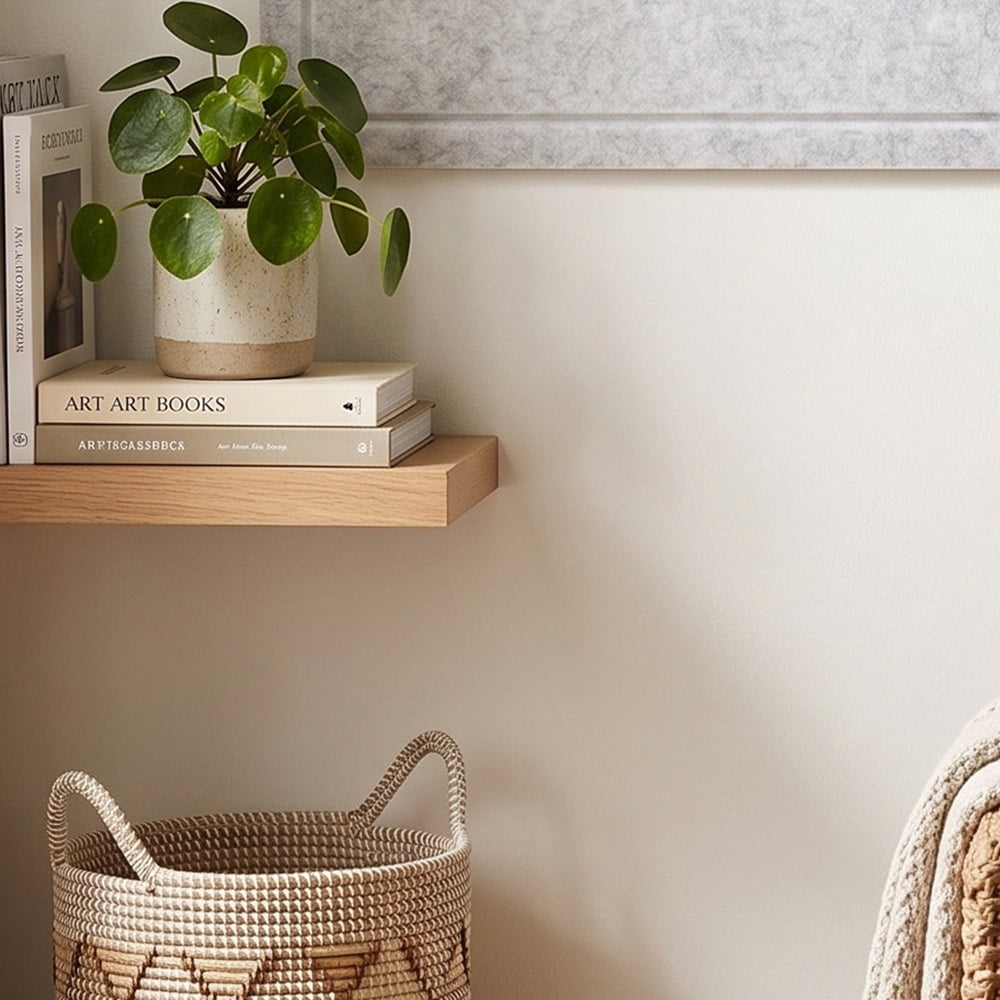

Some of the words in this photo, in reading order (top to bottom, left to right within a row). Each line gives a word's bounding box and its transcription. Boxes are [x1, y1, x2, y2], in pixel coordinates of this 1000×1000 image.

[65, 395, 105, 412] ART
[110, 396, 151, 412] ART
[156, 396, 226, 413] BOOKS
